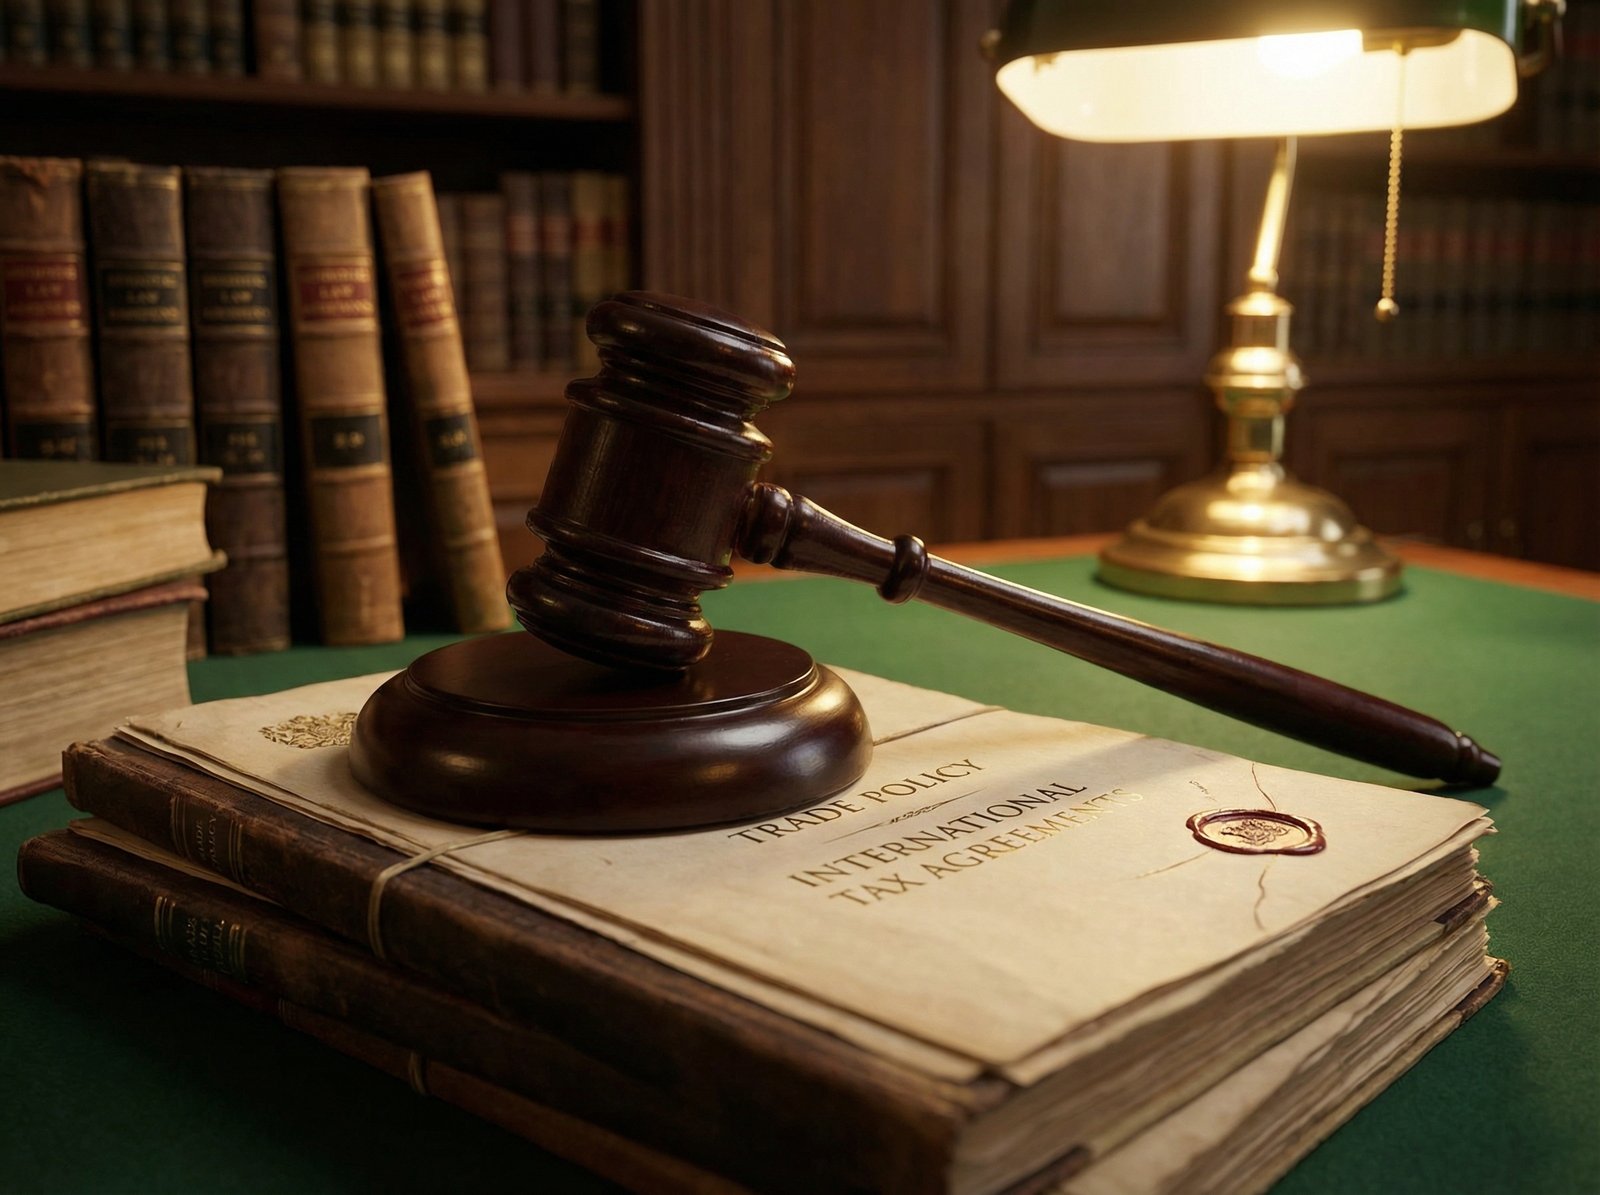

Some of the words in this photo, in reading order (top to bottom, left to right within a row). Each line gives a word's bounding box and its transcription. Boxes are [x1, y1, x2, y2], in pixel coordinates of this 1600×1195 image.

[728, 799, 865, 846] TRADE
[862, 758, 987, 804] POLICY
[788, 780, 1087, 888] INTERNATIONAL
[828, 872, 928, 906] TAX
[920, 787, 1144, 880] AGREEMENTS
